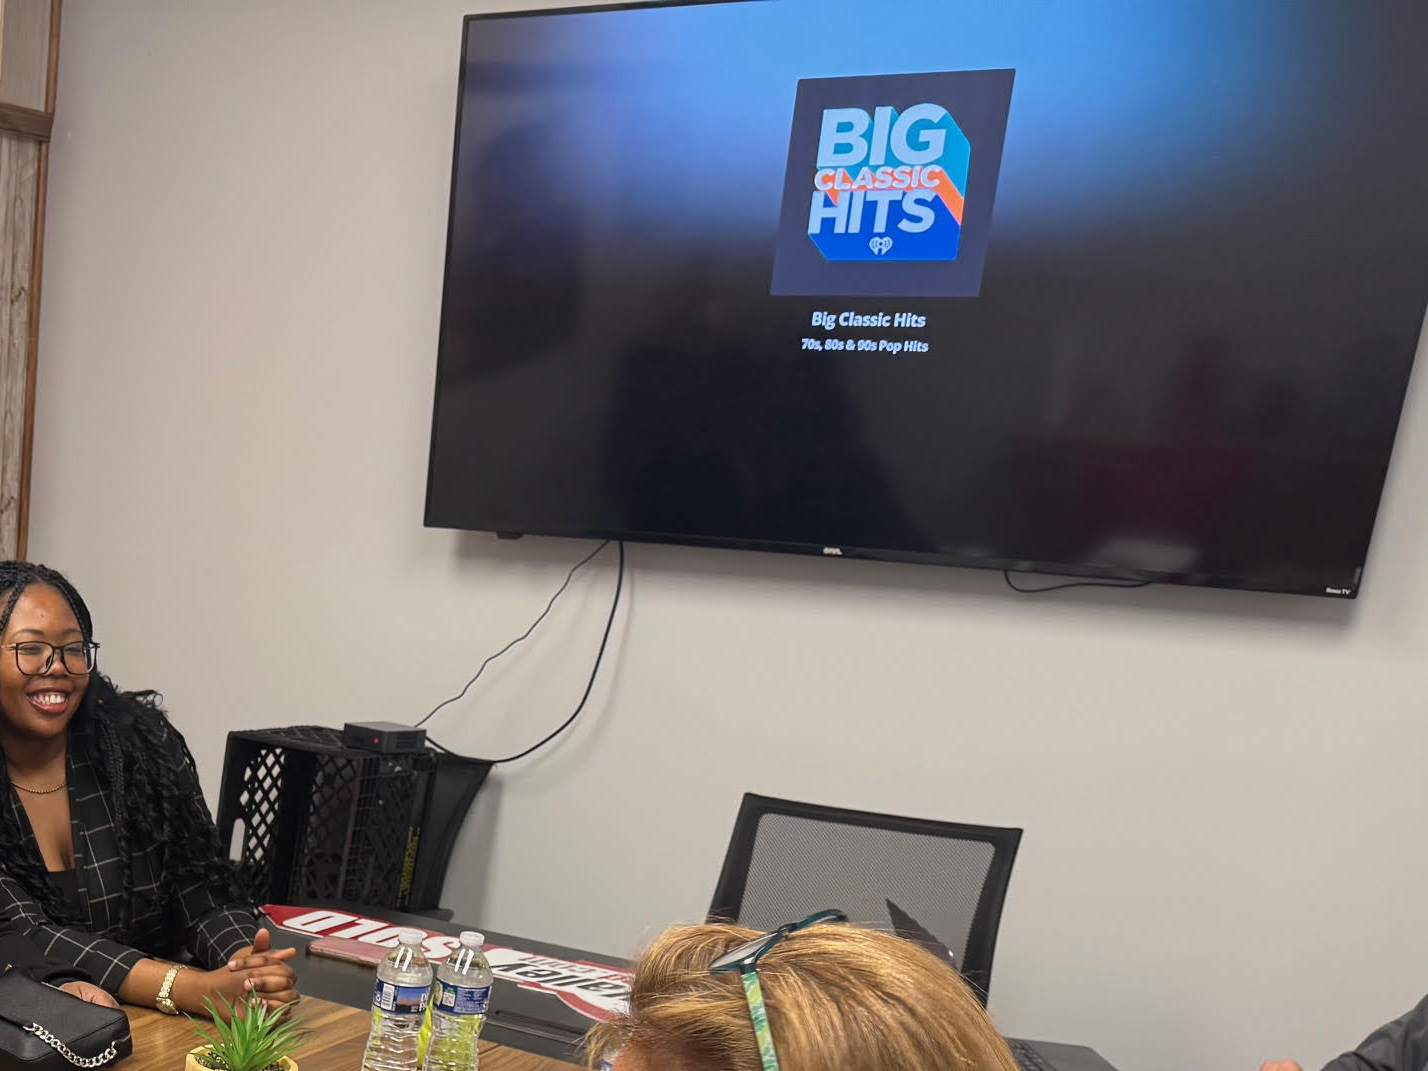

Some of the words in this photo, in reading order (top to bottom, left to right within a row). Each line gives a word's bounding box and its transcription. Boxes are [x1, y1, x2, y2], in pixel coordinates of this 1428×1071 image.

[817, 102, 949, 168] BIG
[814, 165, 944, 191] CLASSIC
[808, 190, 937, 235] HITS
[811, 311, 837, 331] Big
[838, 311, 891, 328] Classic
[893, 312, 927, 329] Hits
[800, 338, 823, 352] 70s,
[824, 340, 845, 352] 80s
[845, 340, 856, 352] &
[857, 340, 877, 352] 90s
[878, 340, 902, 355] Pop
[903, 340, 929, 353] Hits
[281, 909, 461, 960] SOLD
